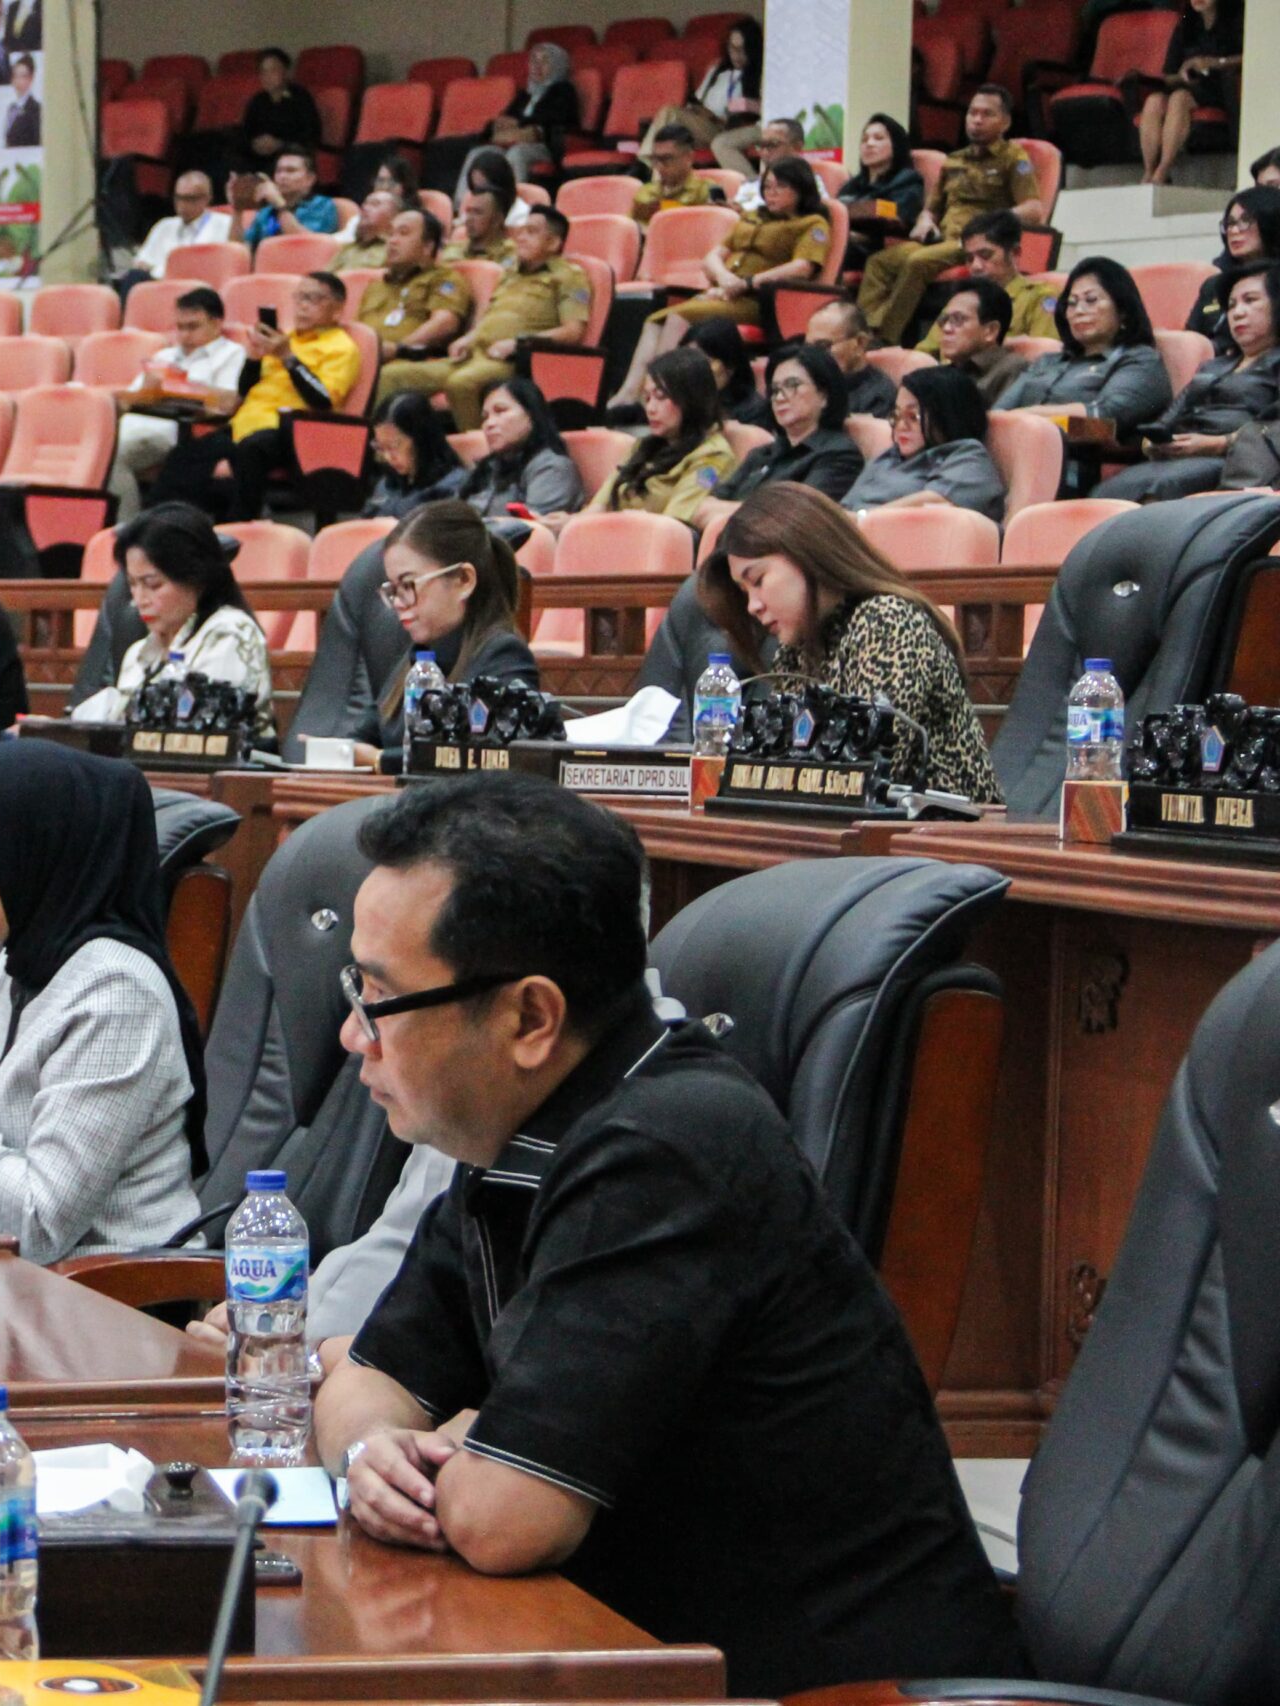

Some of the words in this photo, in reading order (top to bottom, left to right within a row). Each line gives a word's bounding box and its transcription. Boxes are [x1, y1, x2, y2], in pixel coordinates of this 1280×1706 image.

[566, 767, 635, 785] SEKRETARIAT
[638, 769, 666, 787] DPRD
[231, 1258, 277, 1281] AQUA
